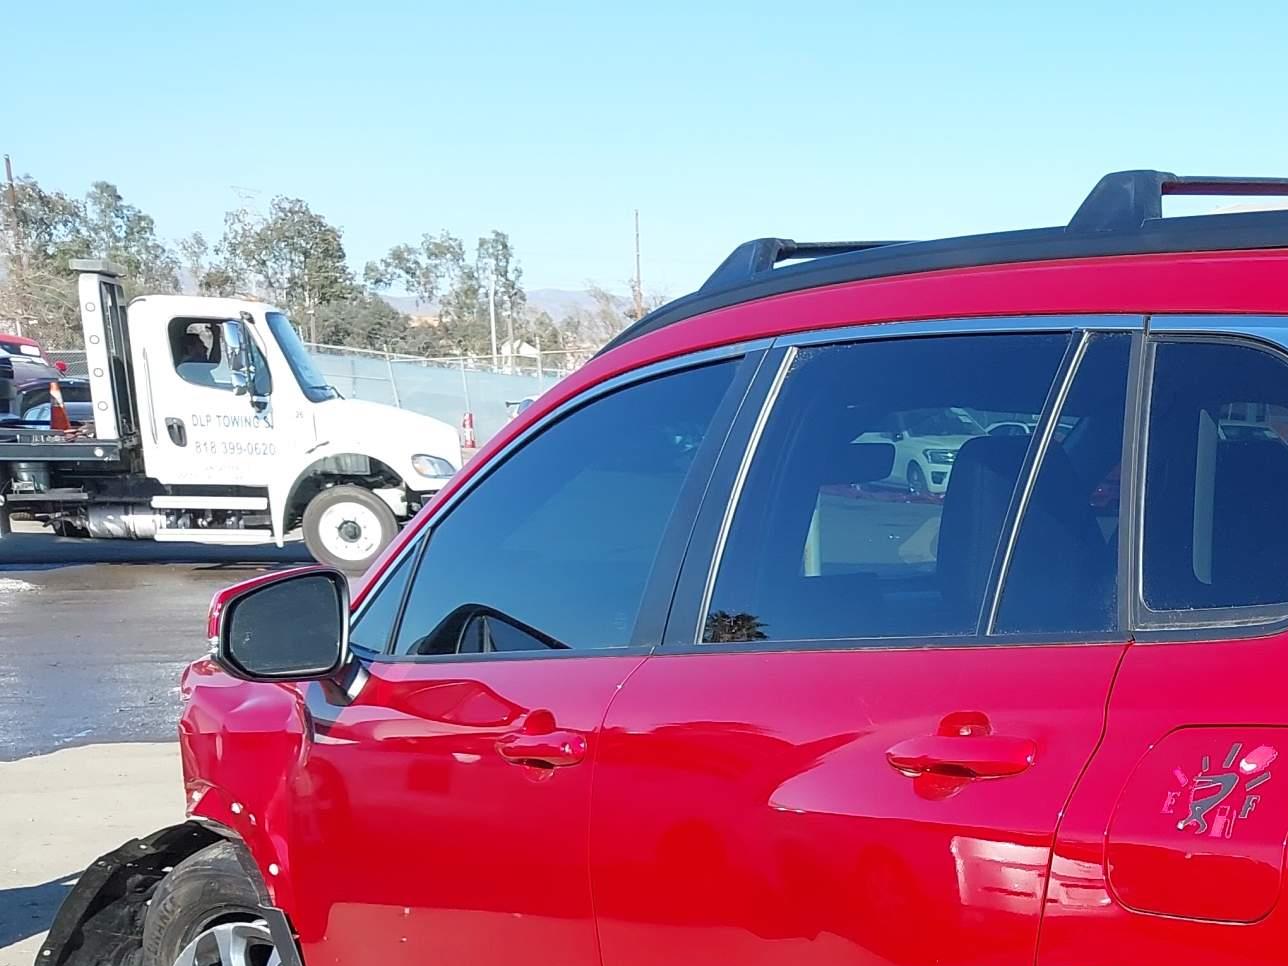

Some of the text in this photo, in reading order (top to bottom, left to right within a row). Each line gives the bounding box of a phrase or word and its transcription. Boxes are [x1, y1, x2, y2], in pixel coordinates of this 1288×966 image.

[192, 414, 211, 427] DLP
[216, 415, 260, 429] TOWING
[195, 441, 277, 456] 818 399-0620
